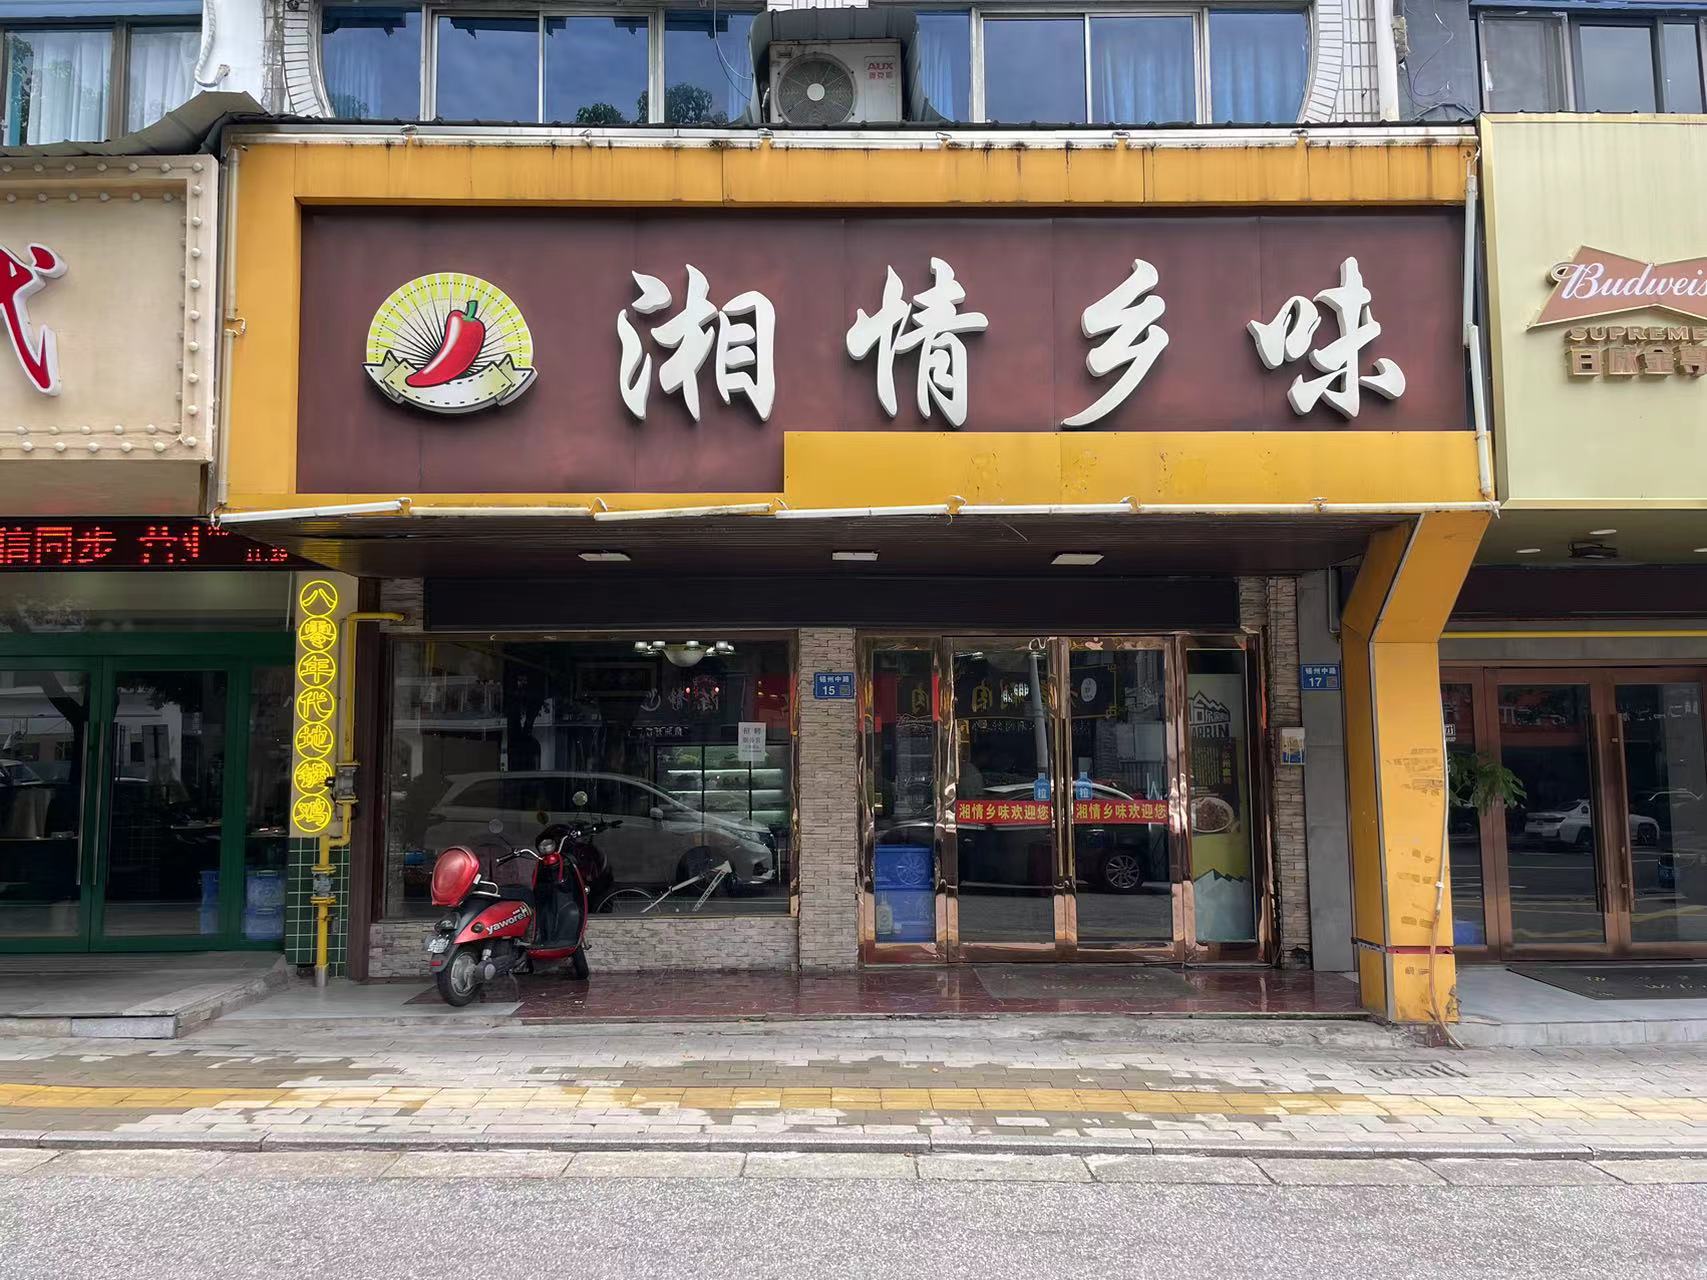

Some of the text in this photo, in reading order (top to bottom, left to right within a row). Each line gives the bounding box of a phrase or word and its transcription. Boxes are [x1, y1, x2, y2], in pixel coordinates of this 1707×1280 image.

[867, 62, 893, 70] AUX
[617, 256, 1406, 428] 湘情乡味
[822, 685, 836, 695] 15
[1308, 677, 1322, 687] 17
[293, 581, 338, 832] 八零年代地锅鸡
[958, 804, 1050, 820] 湘情乡味欢迎您
[1076, 803, 1167, 819] 湘情乡味欢迎您
